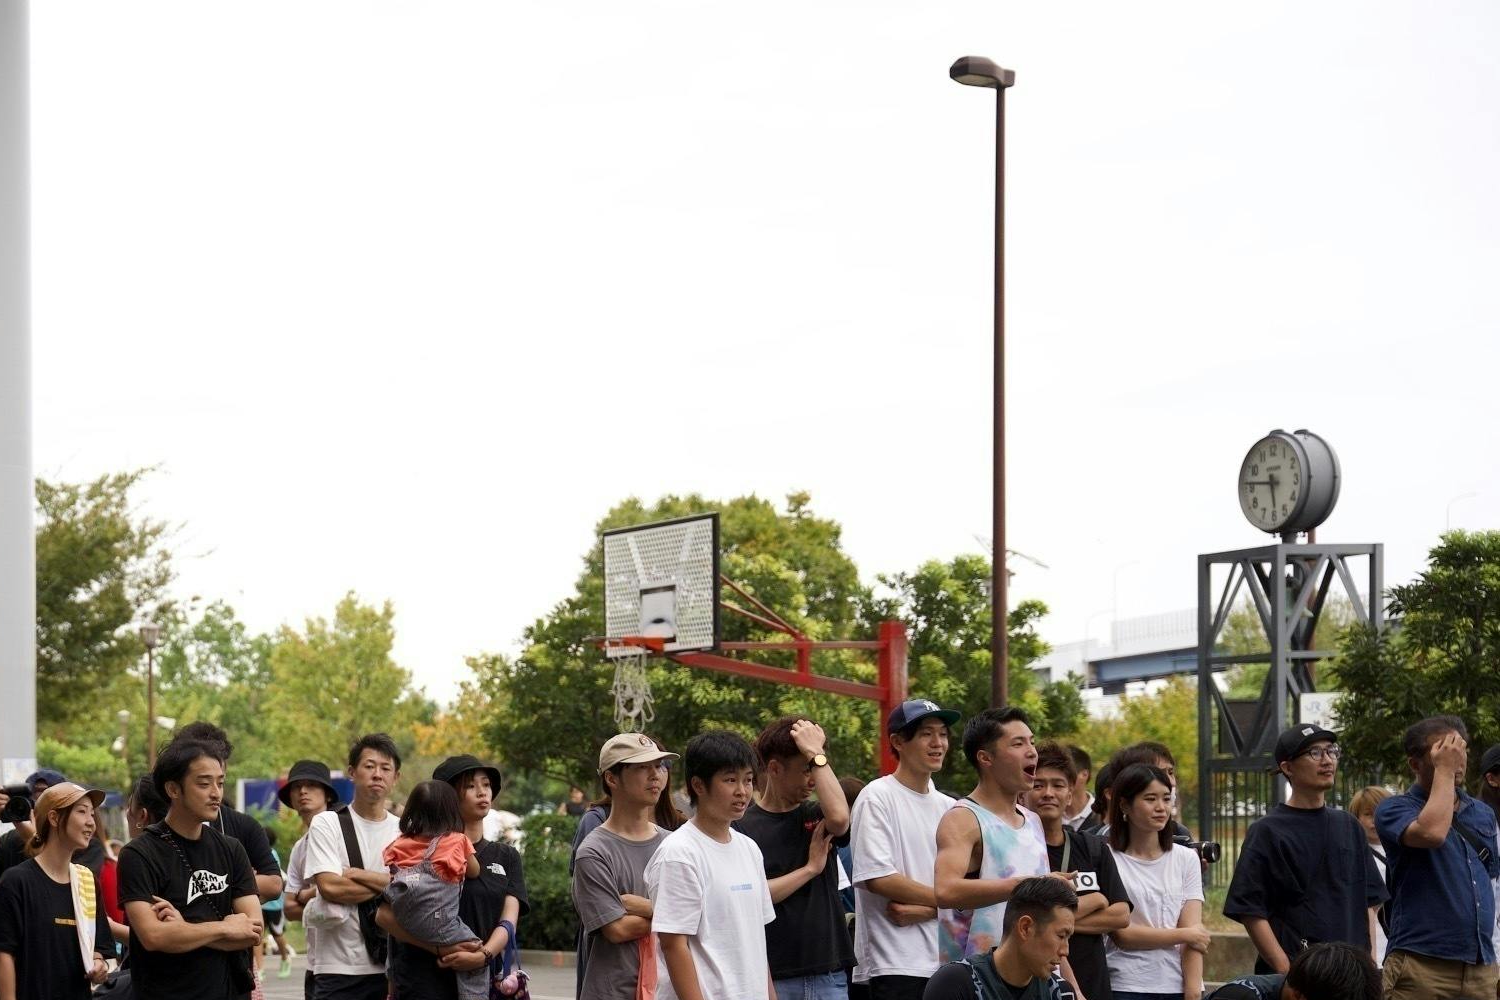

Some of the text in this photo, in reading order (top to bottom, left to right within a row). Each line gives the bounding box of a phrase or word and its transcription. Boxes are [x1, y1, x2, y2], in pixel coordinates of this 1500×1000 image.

[1260, 450, 1266, 462] 11
[1269, 444, 1277, 457] 12
[1282, 447, 1286, 459] 1
[1251, 464, 1259, 476] 10
[1290, 457, 1296, 470] 2
[1293, 472, 1299, 486] 3
[1252, 496, 1259, 509] 8
[1290, 490, 1296, 502] 4
[1260, 507, 1267, 520] 7
[1271, 510, 1277, 522] 6
[1282, 503, 1288, 517] 5
